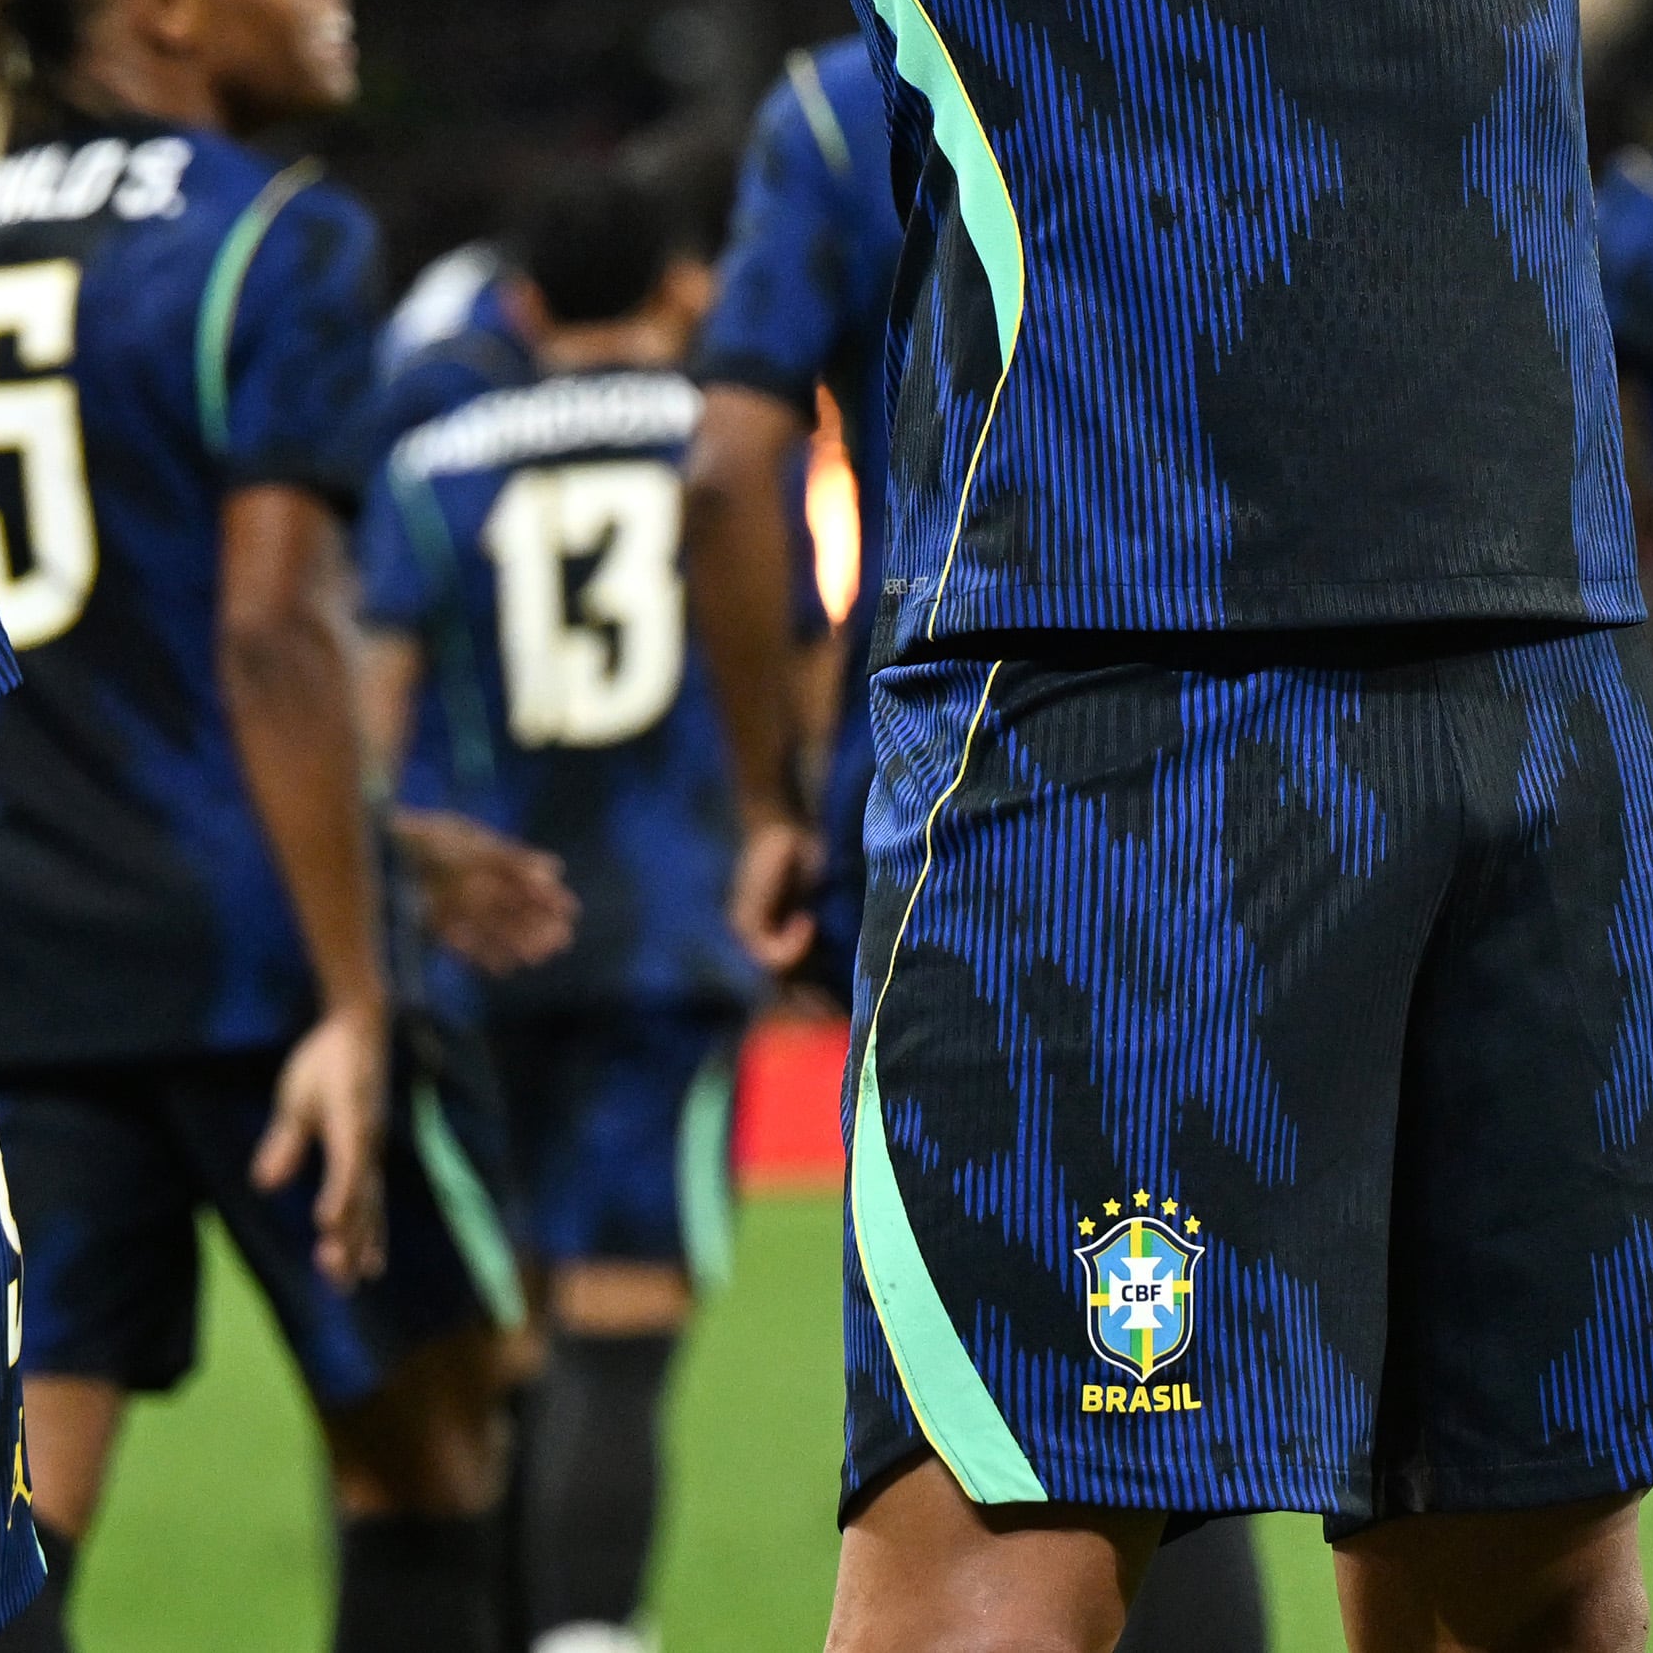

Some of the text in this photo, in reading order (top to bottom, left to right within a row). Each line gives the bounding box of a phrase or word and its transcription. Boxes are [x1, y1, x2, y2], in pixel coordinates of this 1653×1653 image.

[482, 458, 687, 748] 13
[1121, 1284, 1163, 1302] CBF
[1081, 1382, 1202, 1413] BRASIL
